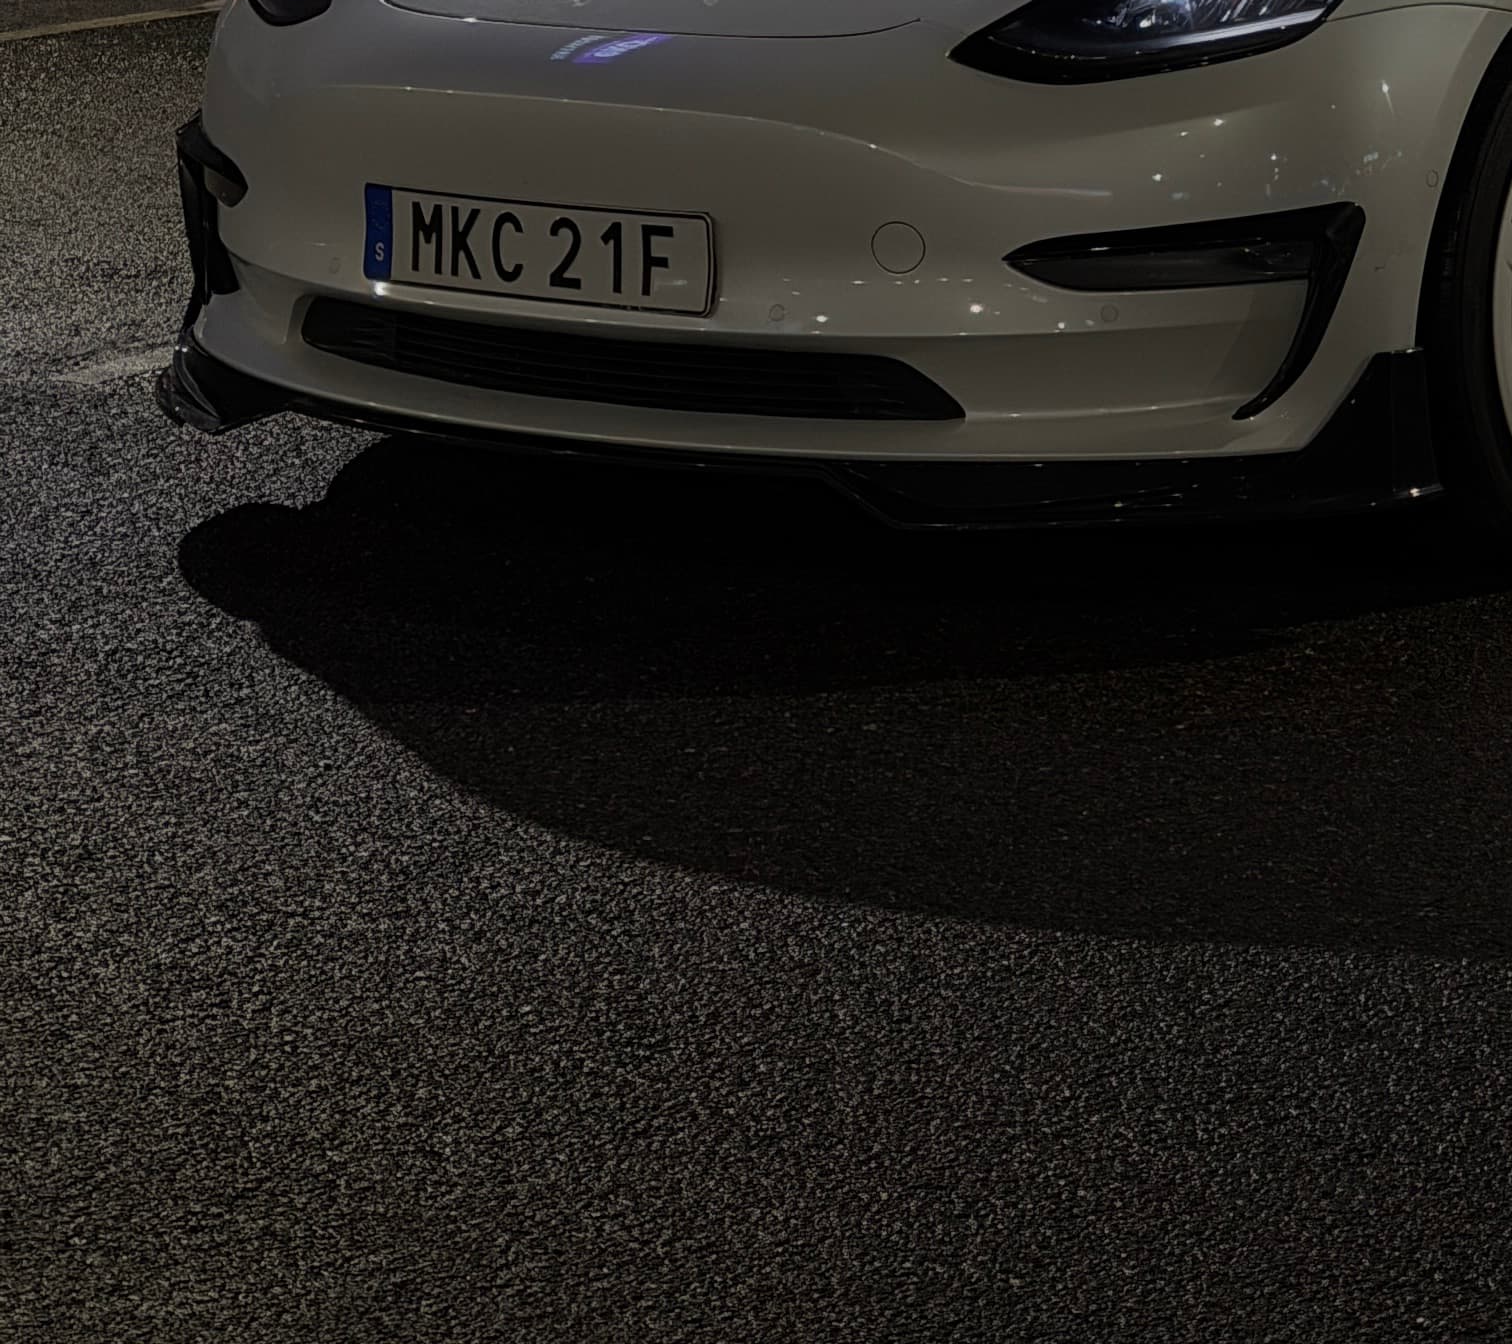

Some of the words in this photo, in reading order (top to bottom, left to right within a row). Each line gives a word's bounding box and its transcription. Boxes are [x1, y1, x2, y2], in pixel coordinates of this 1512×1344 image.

[374, 241, 385, 262] S
[411, 200, 523, 283] MKC
[549, 216, 675, 297] 21F
